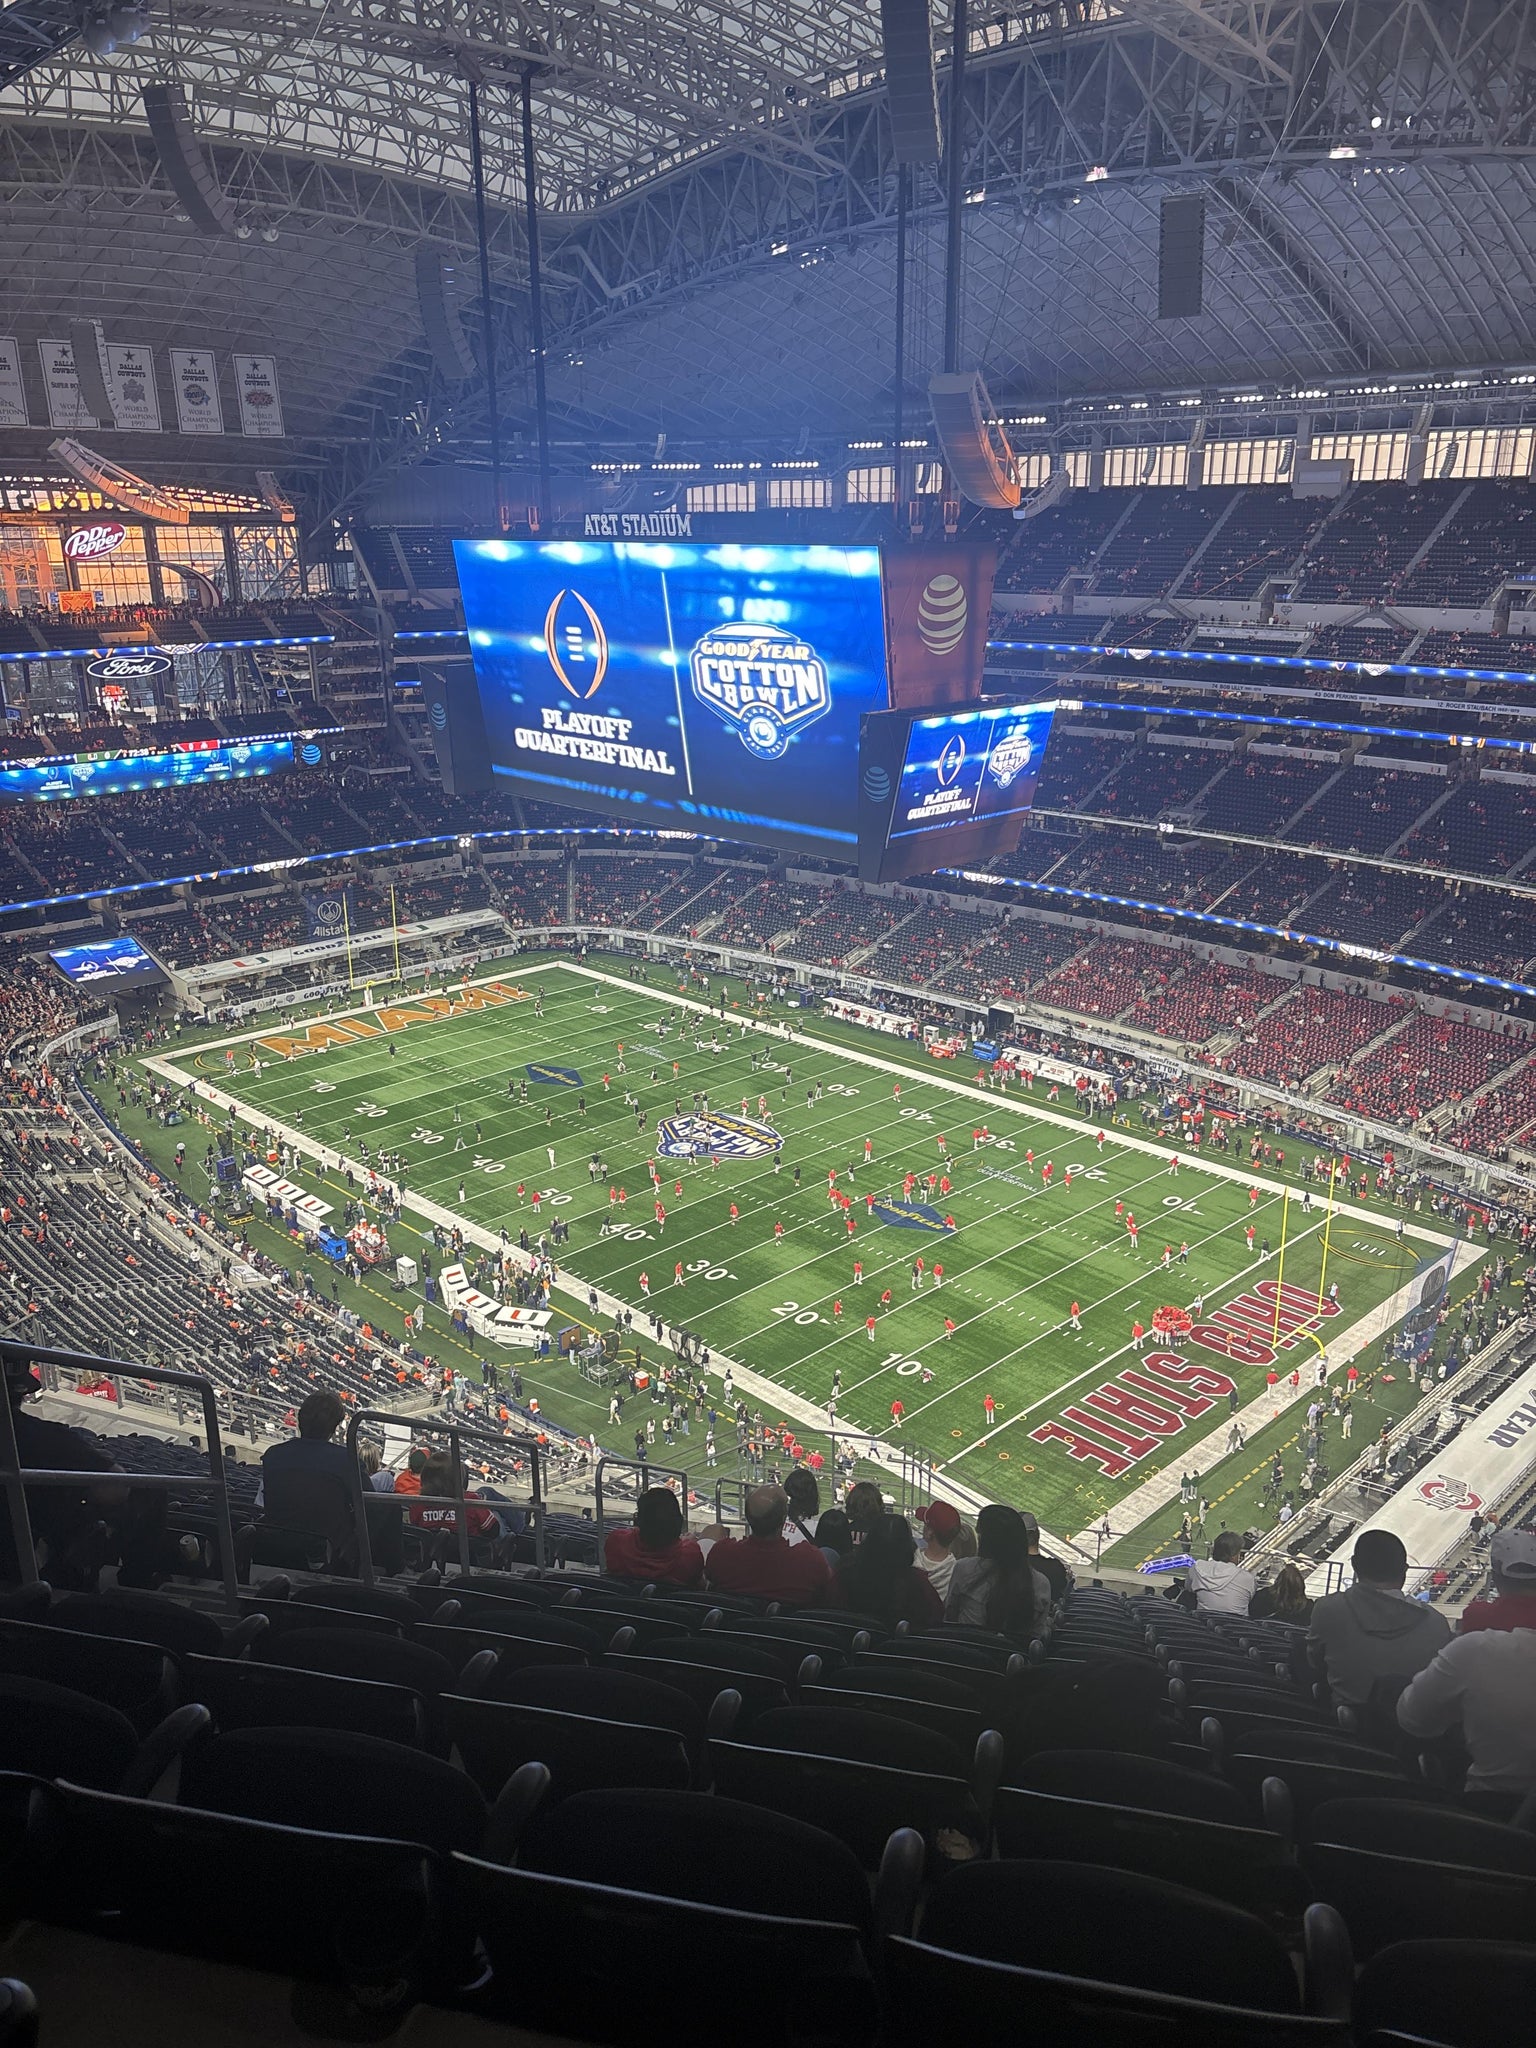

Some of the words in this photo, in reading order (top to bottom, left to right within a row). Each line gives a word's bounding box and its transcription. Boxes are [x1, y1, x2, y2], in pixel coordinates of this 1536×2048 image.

[117, 370, 147, 378] COWBOYS
[119, 363, 143, 371] DALLAS
[182, 368, 206, 376] DALLAS
[90, 526, 112, 541] Dr
[584, 514, 618, 536] AT&T
[621, 514, 693, 536] STADIUM
[70, 530, 124, 557] Pepper
[701, 639, 810, 661] GOODYEAR
[103, 658, 157, 676] Ford
[700, 658, 819, 707] COTTON
[723, 683, 798, 714] BOWL
[541, 708, 632, 741] PLAYOFF
[743, 706, 782, 727] CLASSIC
[514, 728, 675, 775] QUARTERFINAL
[923, 788, 962, 806] PLAYOFF
[907, 798, 972, 820] QUARTERFINAL
[254, 981, 534, 1057] MIAMI
[831, 1083, 860, 1096] 50
[355, 1103, 389, 1118] 20
[899, 1107, 928, 1122] 40
[411, 1129, 445, 1145] 30
[472, 1157, 506, 1174] 40
[976, 1168, 1038, 1193] QUARTERFINAL
[538, 1187, 573, 1206] 50
[873, 1200, 944, 1230] GOODYEAR
[608, 1222, 647, 1241] 40
[686, 1259, 728, 1281] 30
[770, 1301, 819, 1325] 20
[1187, 1280, 1344, 1366] OHIO
[880, 1352, 923, 1376] 10
[1027, 1351, 1239, 1480] STATE
